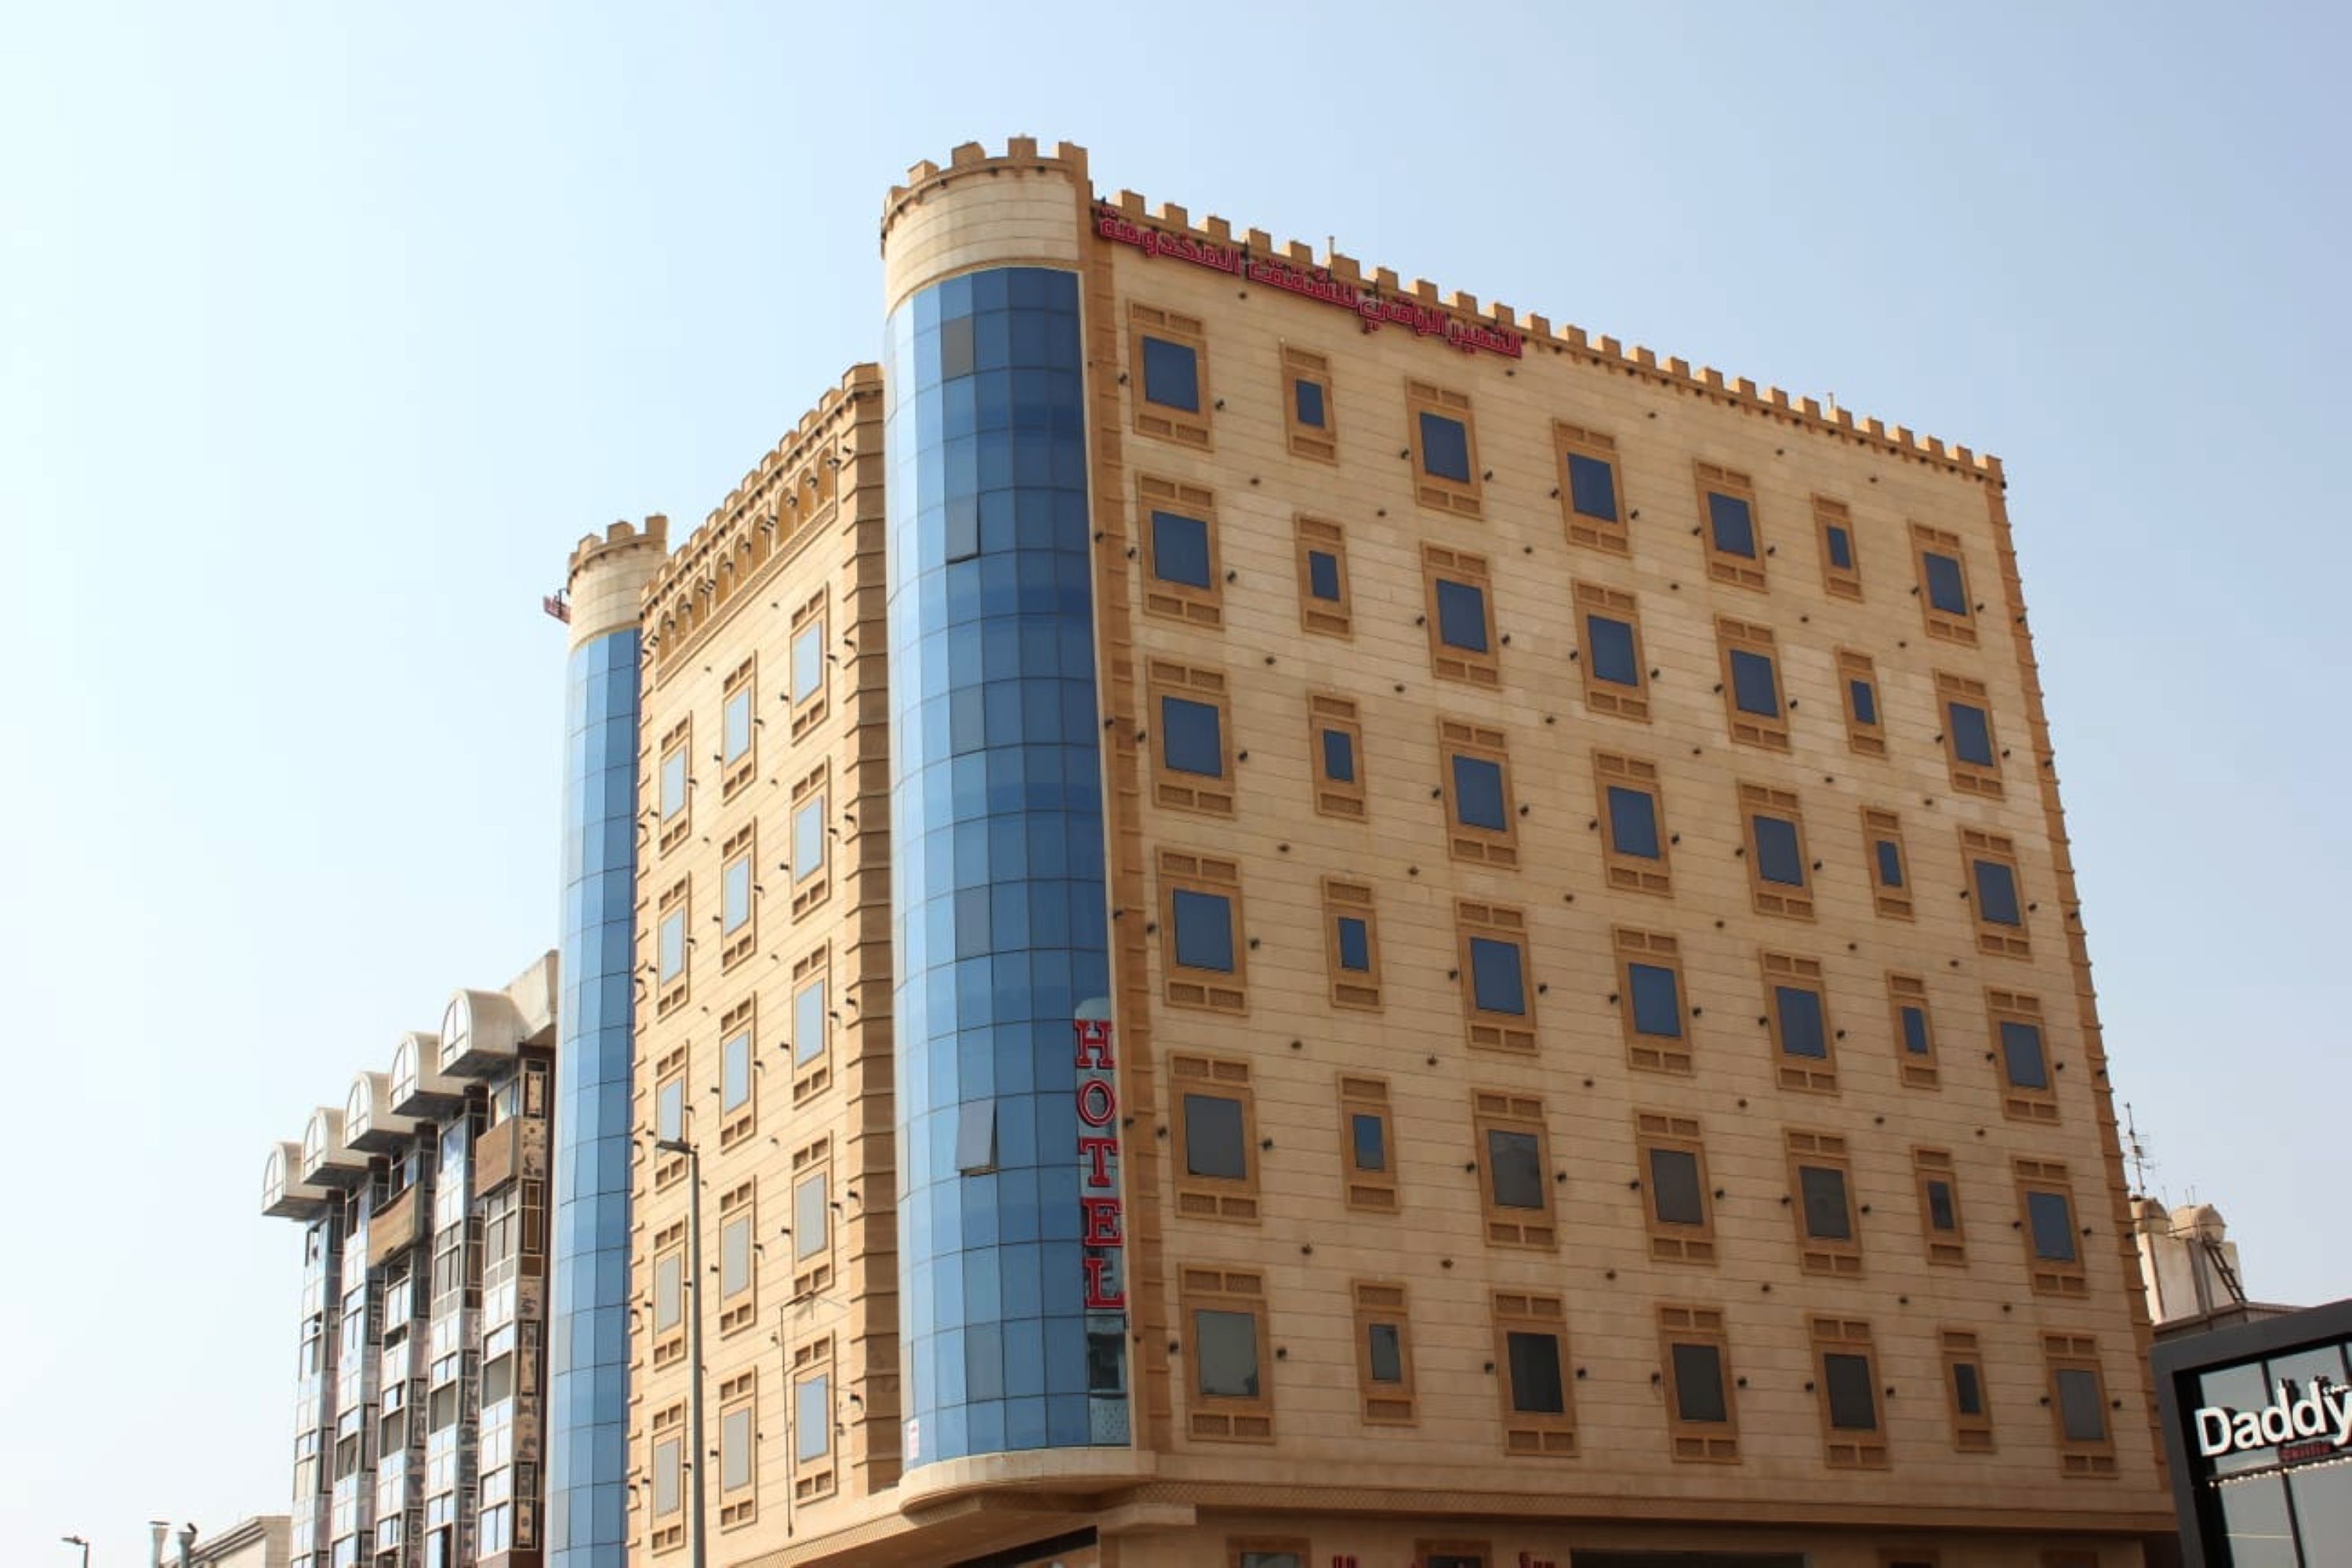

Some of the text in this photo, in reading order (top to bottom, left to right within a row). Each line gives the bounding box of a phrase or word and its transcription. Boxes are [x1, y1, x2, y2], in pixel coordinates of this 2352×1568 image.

[1099, 206, 1240, 274] المخدومة
[1248, 257, 1359, 308] للشقق
[1074, 1021, 1125, 1307] HOTEL
[2194, 1379, 2352, 1457] Daddy
